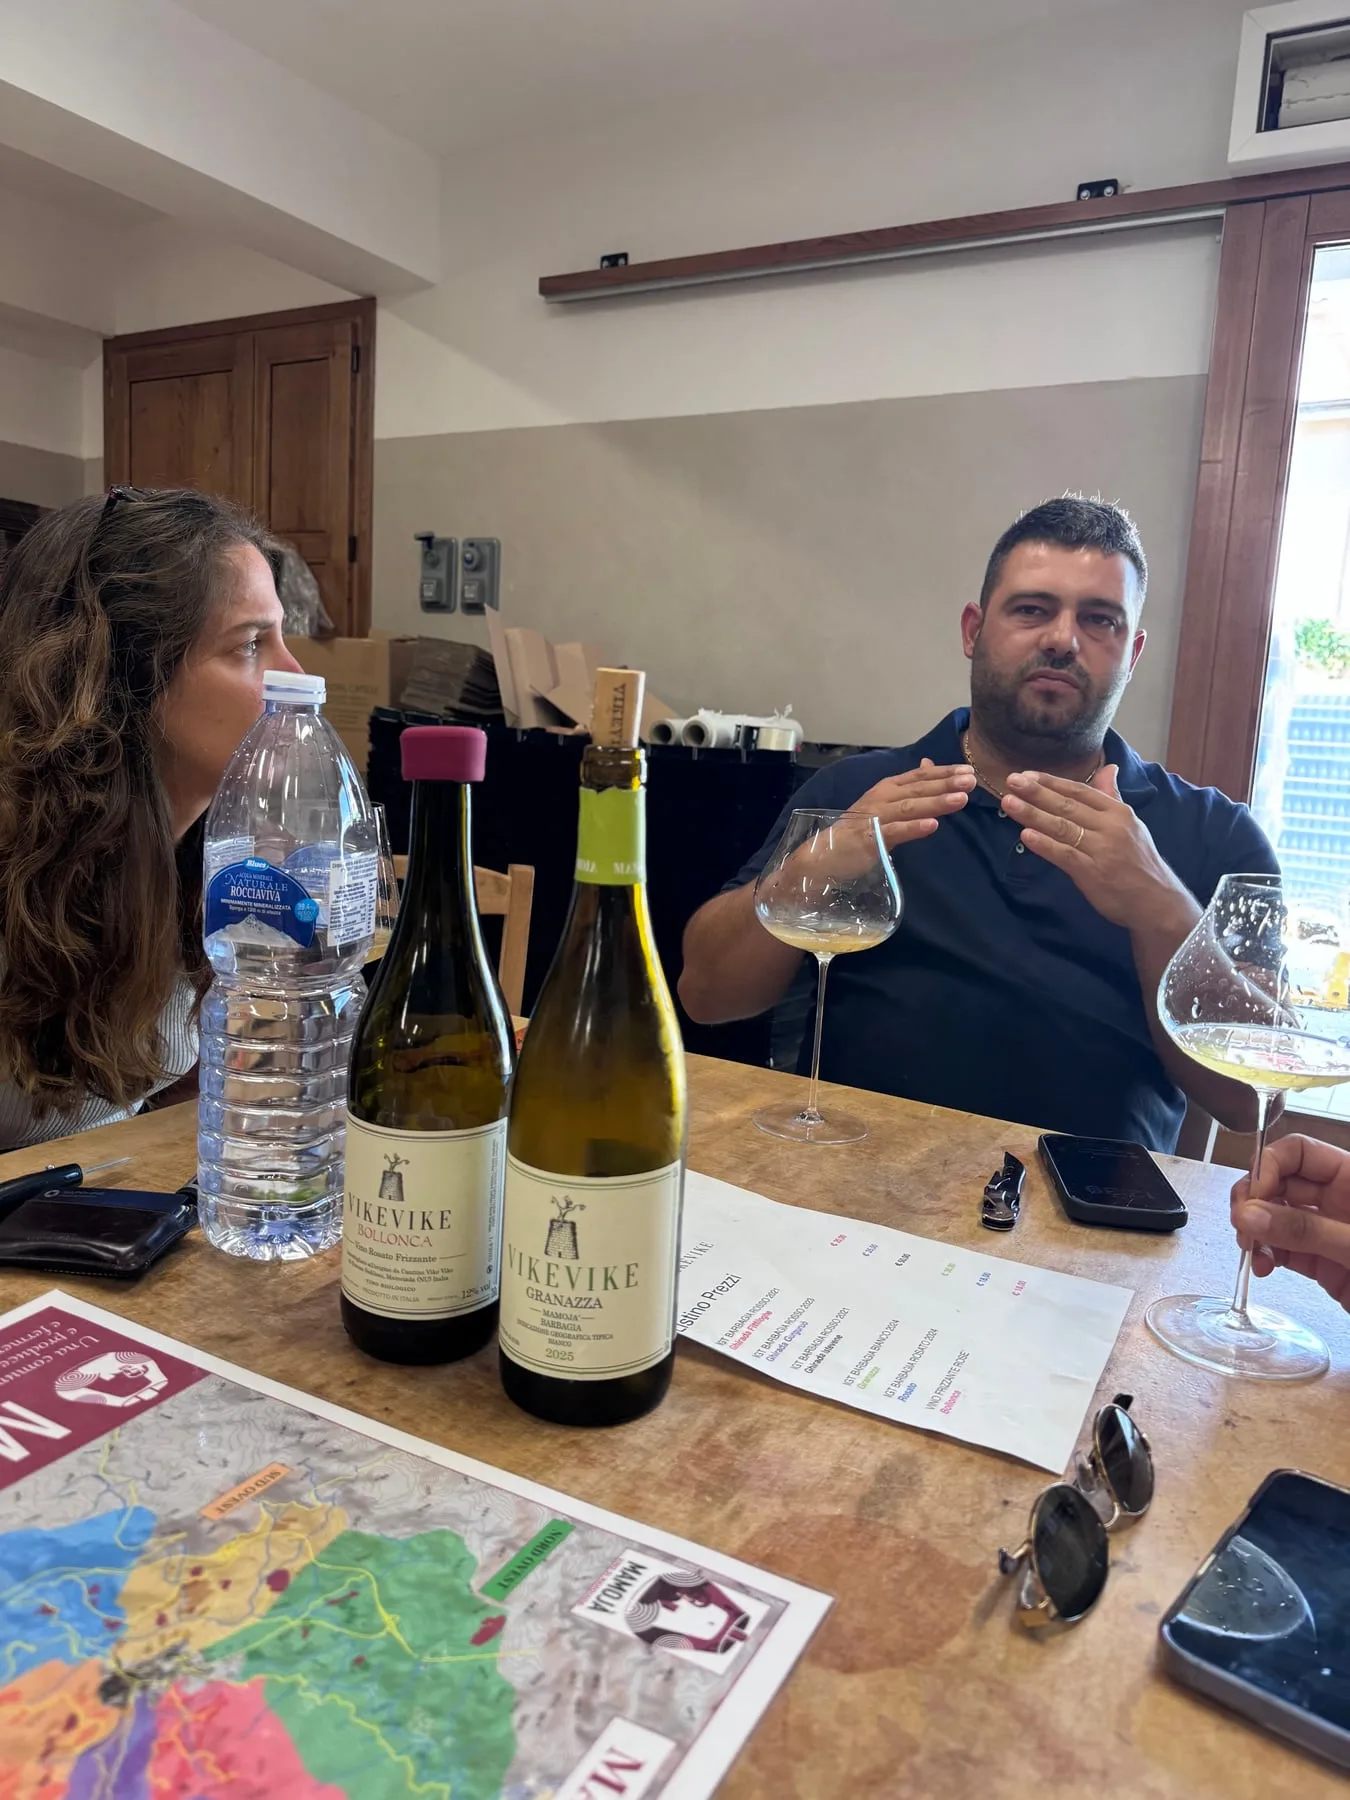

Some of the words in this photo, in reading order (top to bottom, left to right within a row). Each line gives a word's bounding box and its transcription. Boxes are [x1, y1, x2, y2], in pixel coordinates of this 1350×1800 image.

[230, 885, 281, 902] ROCCIAVIVA
[348, 1191, 452, 1231] VIKEVIKE
[358, 1224, 433, 1248] BOLLONCA
[355, 1240, 368, 1253] Vino
[368, 1247, 394, 1260] Rosato
[396, 1253, 437, 1263] Frizzante
[508, 1243, 640, 1292] VIKEVIKE
[526, 1286, 604, 1309] GRANAZZA
[701, 1273, 742, 1301] Prezzi
[540, 1317, 582, 1332] BARBAGIA
[725, 1310, 752, 1338] BARBAGIA
[751, 1297, 770, 1314] ROSSO
[761, 1322, 788, 1350] BARBAGIA
[785, 1307, 805, 1326] ROSSO
[54, 1335, 100, 1356] Una
[548, 1338, 572, 1347] BIANCO
[550, 1330, 592, 1341] GEOGRAFICA
[592, 1333, 614, 1341] TIPICA
[799, 1336, 824, 1361] BARBAGIA
[820, 1318, 840, 1336] ROSSO
[545, 1347, 575, 1362] 2025
[766, 1341, 789, 1362] Ghirada
[804, 1353, 825, 1374] Ghirada
[850, 1350, 877, 1376] BARBAGIA
[870, 1330, 891, 1351] BIANCO
[891, 1361, 914, 1389] BARBAGIA
[909, 1340, 930, 1363] ROSATO
[925, 1327, 938, 1341] 2024
[897, 1382, 917, 1402] Rosato
[925, 1395, 941, 1410] VINO
[935, 1366, 960, 1396] FRIZZANTE
[254, 1471, 281, 1488] SUD
[216, 1486, 256, 1514] OVEST
[530, 1528, 563, 1557] NORD
[497, 1556, 534, 1589] OVEST
